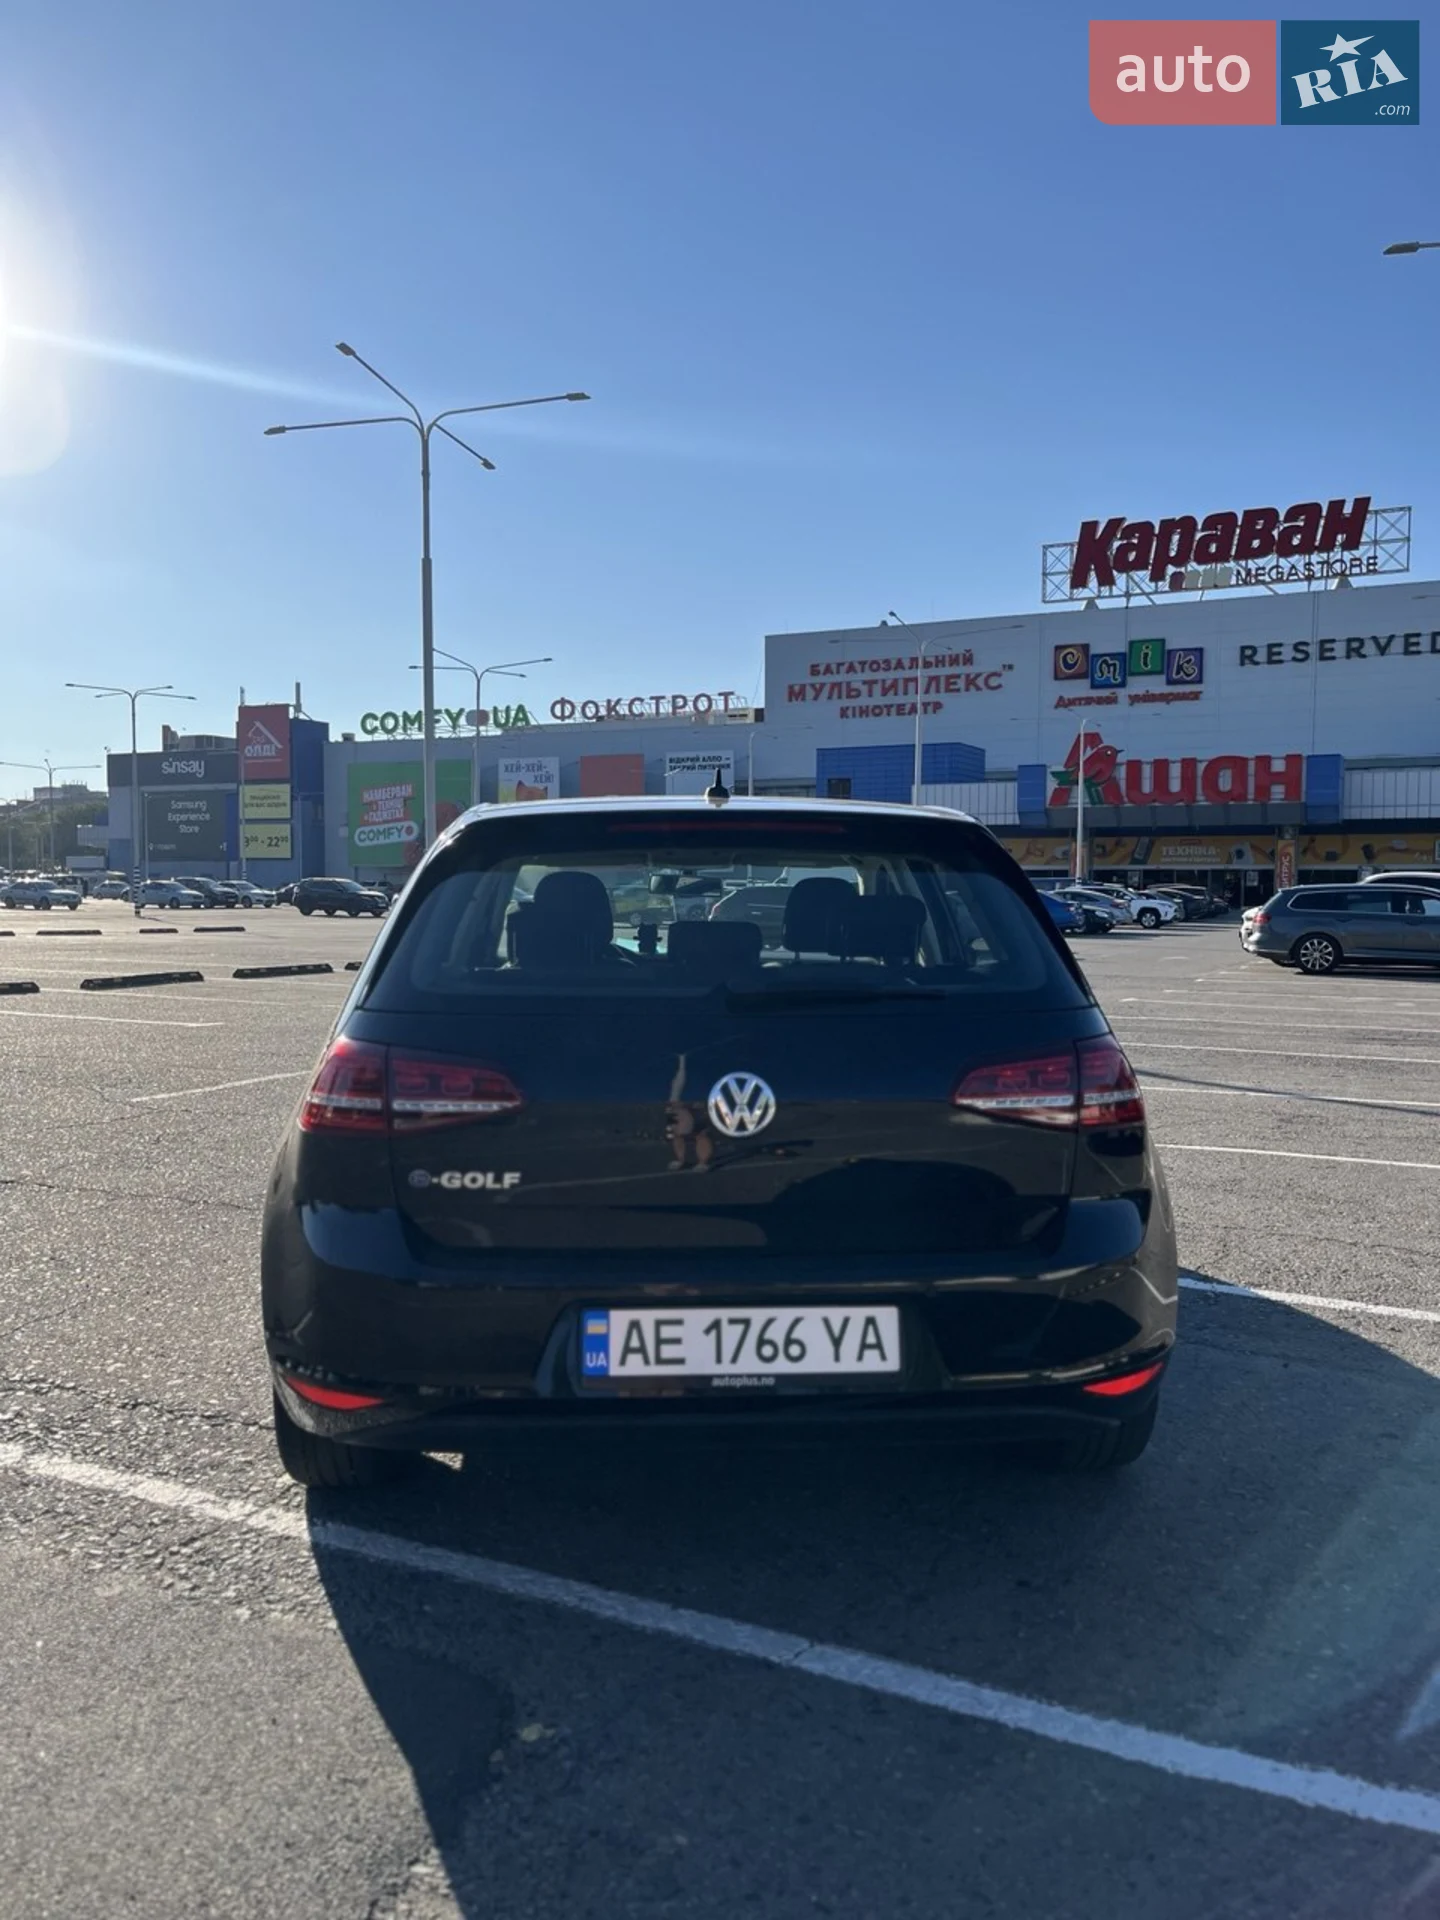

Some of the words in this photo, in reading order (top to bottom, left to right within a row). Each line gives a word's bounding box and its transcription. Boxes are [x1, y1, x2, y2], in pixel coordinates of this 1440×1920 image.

[1235, 556, 1378, 585] MEGASTORE
[809, 649, 974, 677] БАГАТОЗАЛЬНИЙ
[787, 671, 1003, 703] МУЛЬТИПЛЕКС
[550, 691, 735, 722] ФОКСТРОТ
[839, 701, 943, 719] КІНОТЕАТР
[162, 758, 205, 778] sinsay
[171, 800, 207, 811] Samsung
[168, 812, 210, 823] Experience
[179, 824, 200, 834] Store
[357, 825, 405, 842] COMFY
[618, 1318, 686, 1367] AE
[702, 1316, 807, 1365] 1766
[822, 1316, 888, 1363] YA
[586, 1352, 607, 1367] UA
[711, 1375, 776, 1389] autoplus.no
